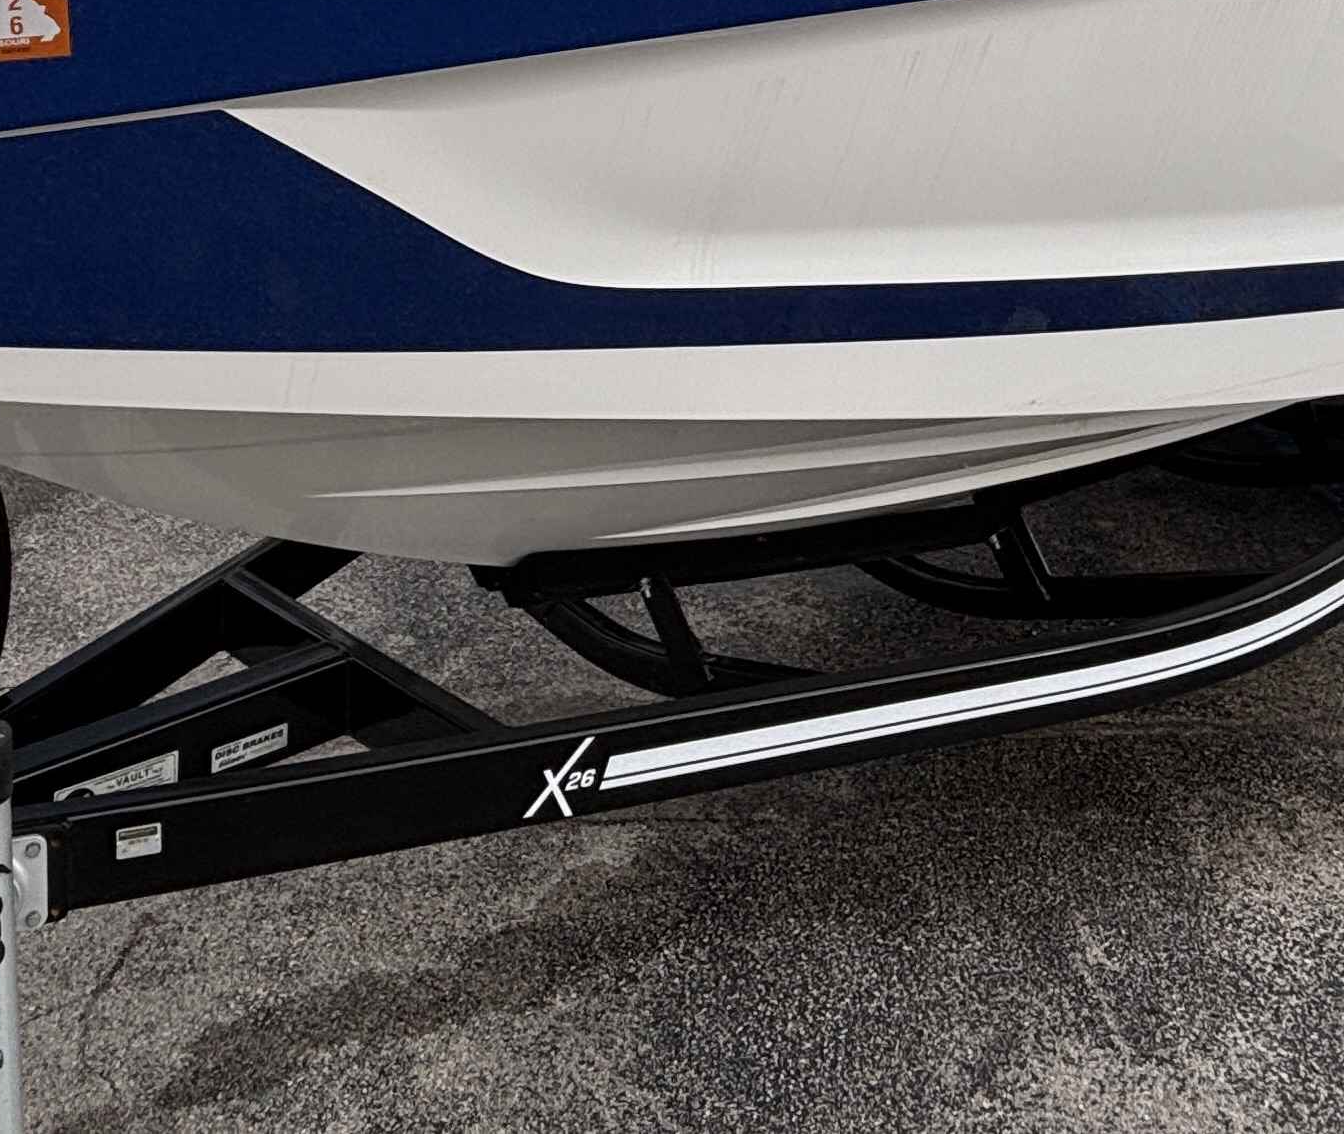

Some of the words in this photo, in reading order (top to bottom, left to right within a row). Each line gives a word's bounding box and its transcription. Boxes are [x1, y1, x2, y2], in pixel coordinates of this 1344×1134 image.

[10, 16, 23, 35] 6
[215, 744, 239, 760] DISC
[243, 729, 283, 751] BRAKES
[115, 769, 149, 786] VAULT
